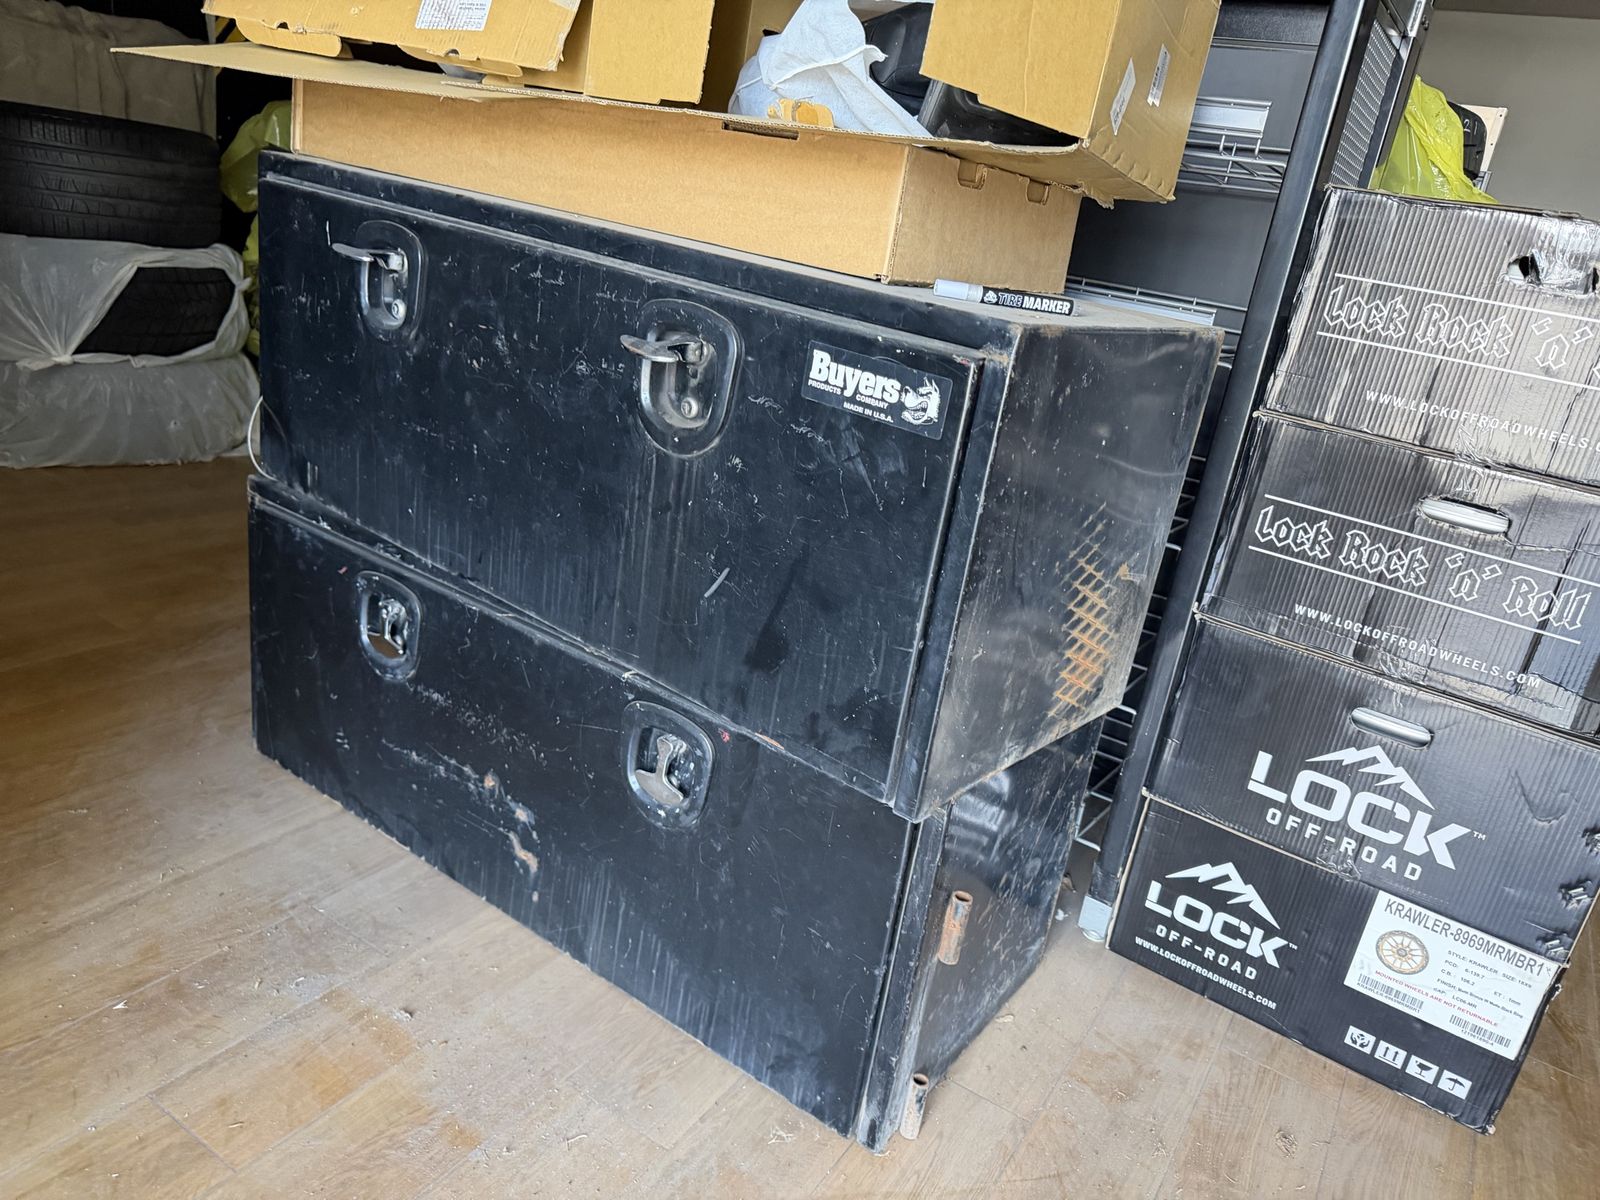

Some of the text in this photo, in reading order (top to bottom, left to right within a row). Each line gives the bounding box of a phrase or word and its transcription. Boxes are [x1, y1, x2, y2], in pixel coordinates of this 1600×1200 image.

[998, 292, 1071, 314] TIRE MARKER
[807, 379, 842, 396] PRODUCTS
[809, 349, 901, 404] Buyers
[855, 393, 889, 410] COMPANY
[843, 402, 894, 423] MADE IN U.S.A.
[1255, 505, 1334, 560] Lock
[1338, 529, 1430, 588] Rock
[1502, 575, 1593, 631] Roll
[1294, 603, 1542, 689] WWW.LOCKOFFROADWHEELS.COM
[1247, 750, 1472, 871] LOCK
[1265, 807, 1423, 882] OFF-ROAD
[1145, 880, 1290, 969] LOCK
[1155, 923, 1258, 981] OFF-ROAD
[1384, 898, 1545, 977] KRAWLER-8969MRMBR1
[1135, 936, 1278, 1011] WWW.LOCKOFFROADWHEELS.COM
[1468, 959, 1499, 974] KRAWLER
[1375, 970, 1499, 1027] MOUNTED WHEELS ARE NOT RETURNABLE
